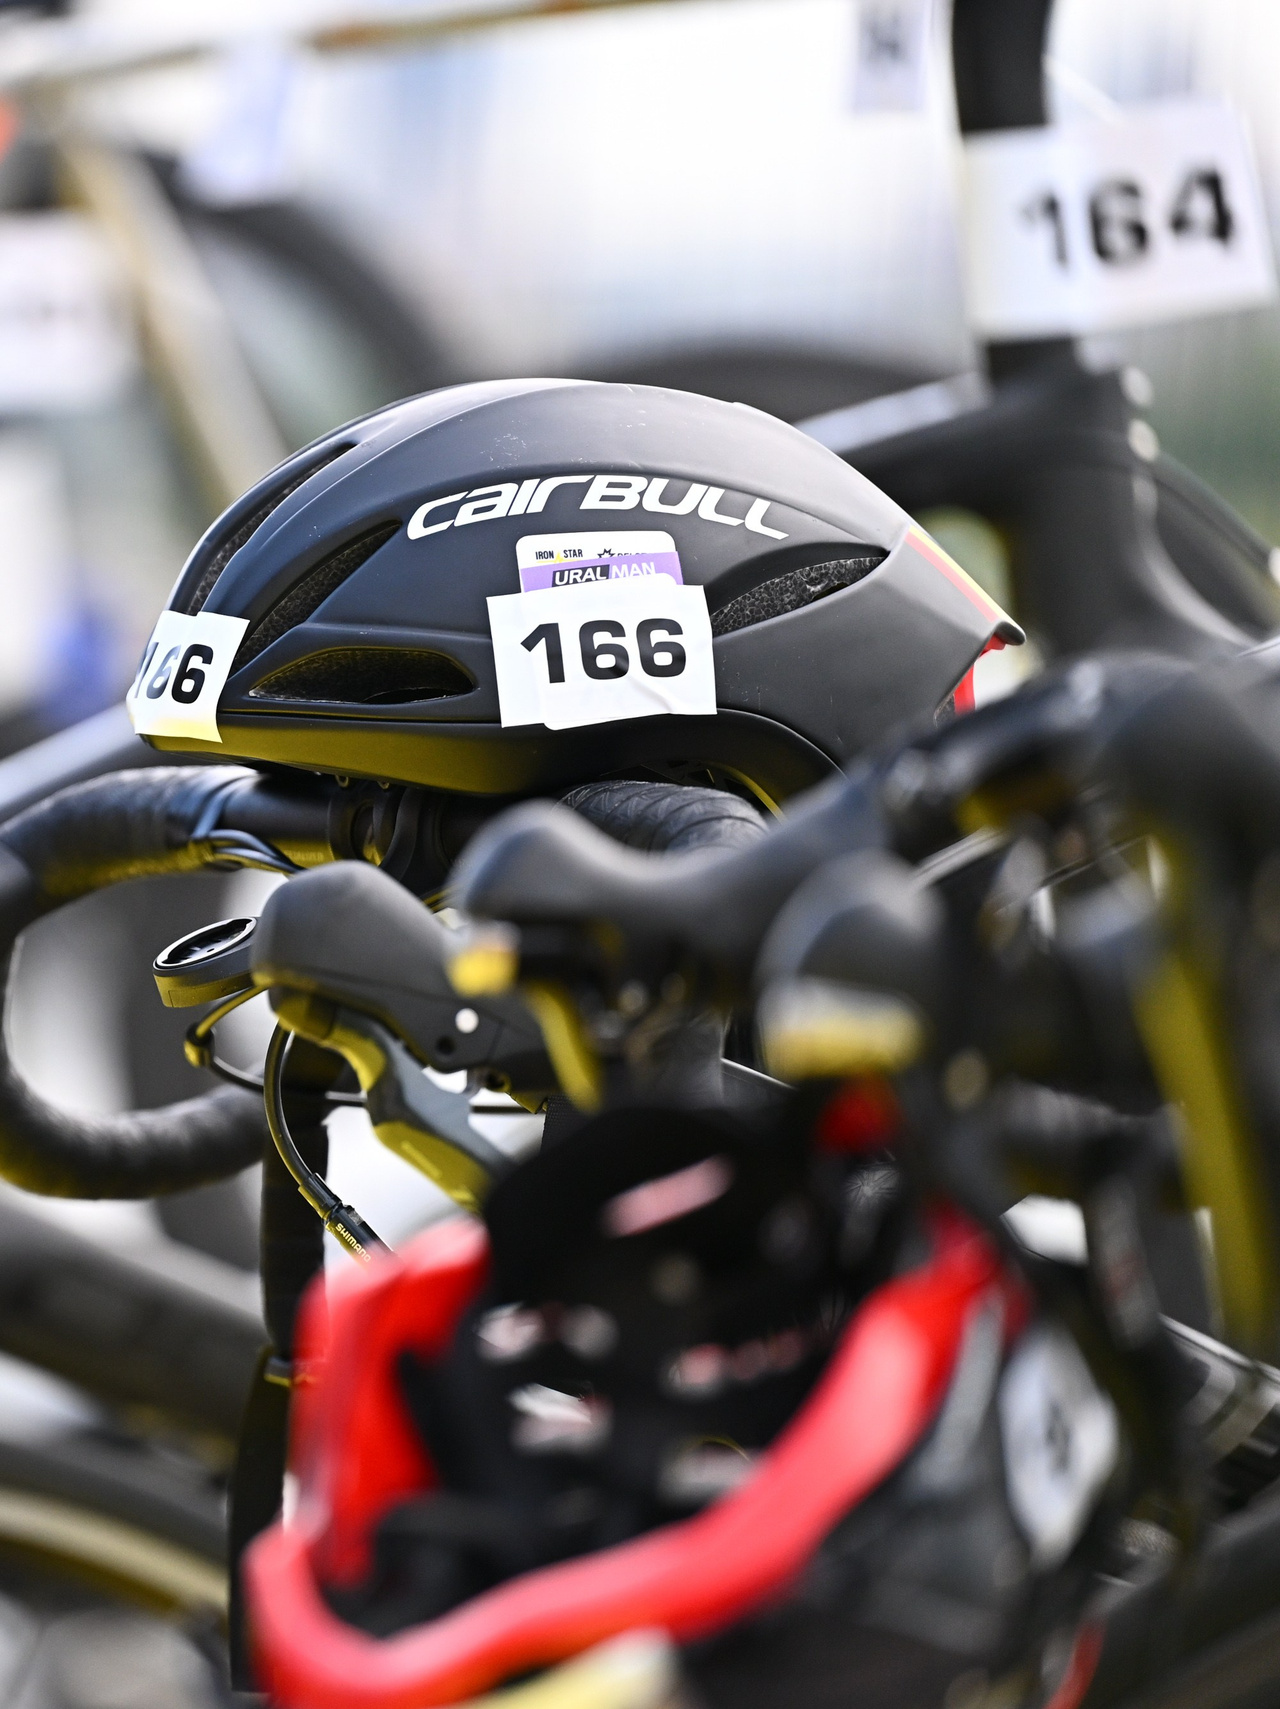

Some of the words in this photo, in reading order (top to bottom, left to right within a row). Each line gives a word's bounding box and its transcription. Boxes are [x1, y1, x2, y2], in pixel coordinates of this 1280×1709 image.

[1018, 166, 1234, 269] 164
[535, 550, 555, 560] IRON
[563, 548, 583, 559] STAR
[554, 566, 607, 586] URAL
[611, 561, 657, 579] MAN
[134, 641, 214, 705] 166
[520, 617, 687, 684] 166
[335, 1222, 372, 1263] SHIMANO
